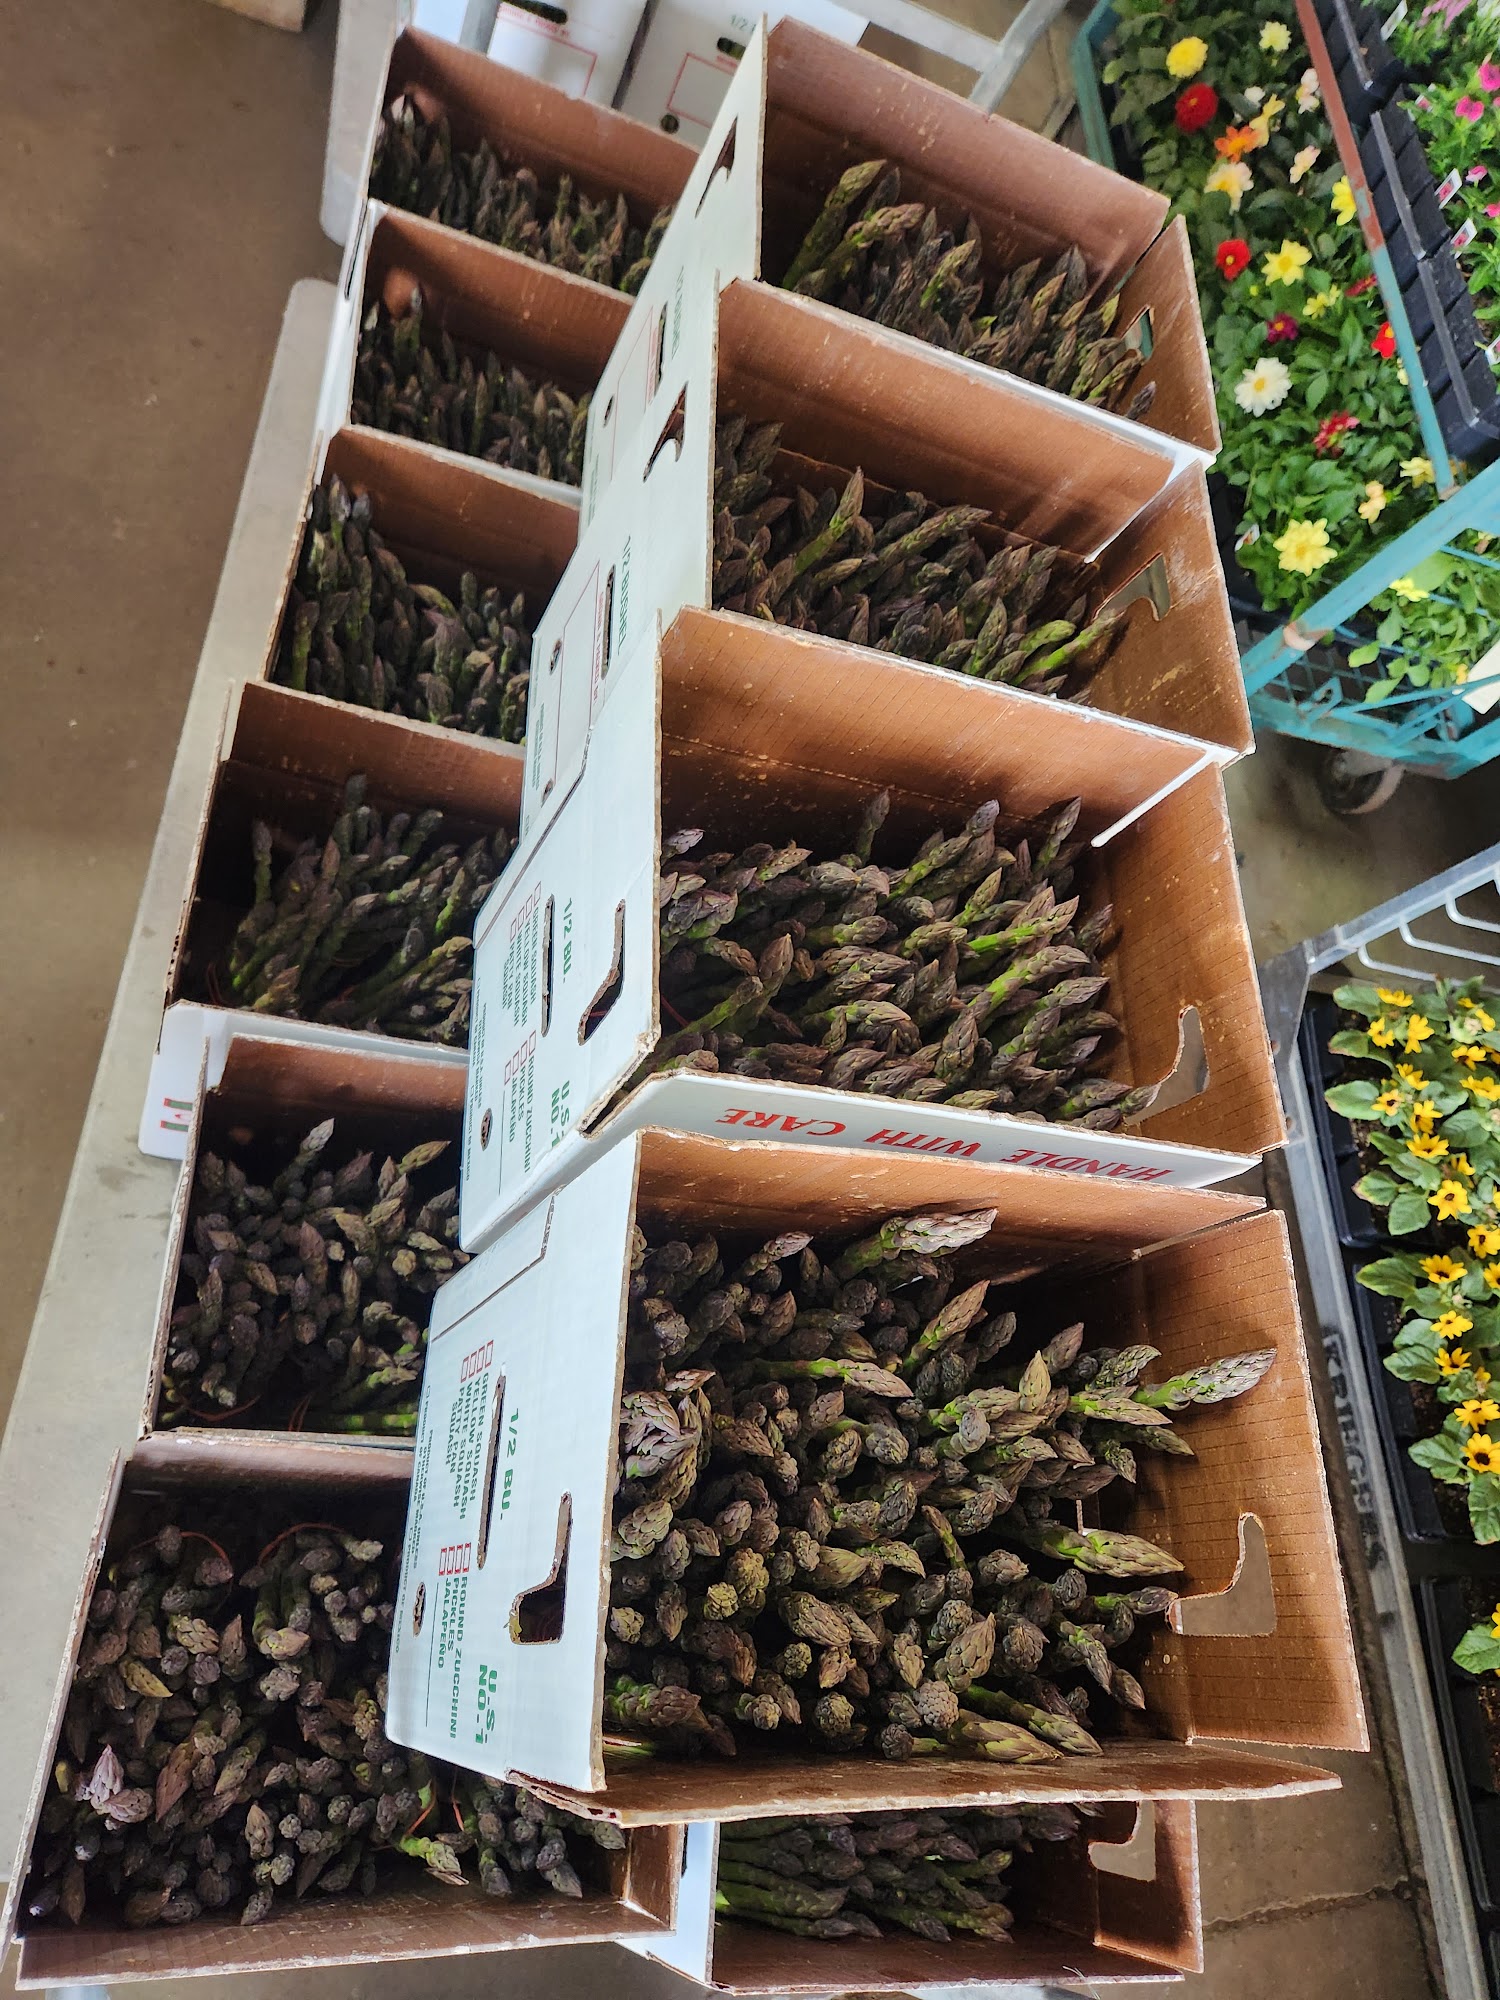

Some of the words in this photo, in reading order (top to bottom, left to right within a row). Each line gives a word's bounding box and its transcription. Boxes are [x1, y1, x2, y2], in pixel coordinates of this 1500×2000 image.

[622, 535, 631, 573] 1/2
[617, 570, 630, 656] BUSHEL
[523, 919, 531, 971] YELLOW
[563, 898, 573, 939] 1/2
[515, 929, 523, 971] WHITE
[563, 940, 573, 984] BU.
[513, 972, 521, 1027] SQUASH
[521, 972, 529, 1027] SQUASH
[530, 950, 538, 1005] SQUASH
[518, 1065, 526, 1122] PICKLES
[526, 1054, 535, 1105] ROUND
[560, 1079, 571, 1138] U.S.
[715, 1107, 847, 1137] CARE
[524, 1106, 533, 1174] ZUCCHINI
[863, 1128, 983, 1158] WITH
[1001, 1148, 1175, 1182] HANDLE
[420, 1400, 429, 1444] PRODUCT
[454, 1386, 465, 1435] PATTY
[462, 1381, 473, 1434] WHITE
[468, 1376, 481, 1444] YELLOW
[478, 1372, 489, 1427] GREEN
[424, 1429, 433, 1474] PRODUCT
[445, 1401, 458, 1466] SQUASH
[449, 1441, 459, 1474] PAN
[506, 1407, 519, 1459] 1/2
[413, 1460, 421, 1502] CANADA
[416, 1446, 427, 1506] OTHERWISE
[453, 1438, 467, 1507] SQUASH
[459, 1449, 473, 1520] SQUASH
[469, 1430, 483, 1501] SQUASH
[500, 1468, 514, 1521] BU.
[411, 1509, 419, 1554] MARKED
[402, 1544, 411, 1591] PRODUCT
[395, 1610, 404, 1654] MEXICO
[447, 1577, 460, 1652] PICKLES
[456, 1576, 468, 1642] ROUND
[449, 1647, 462, 1739] ZUCCHINI
[475, 1664, 488, 1745] NO.1
[485, 1669, 498, 1744] U.S.
